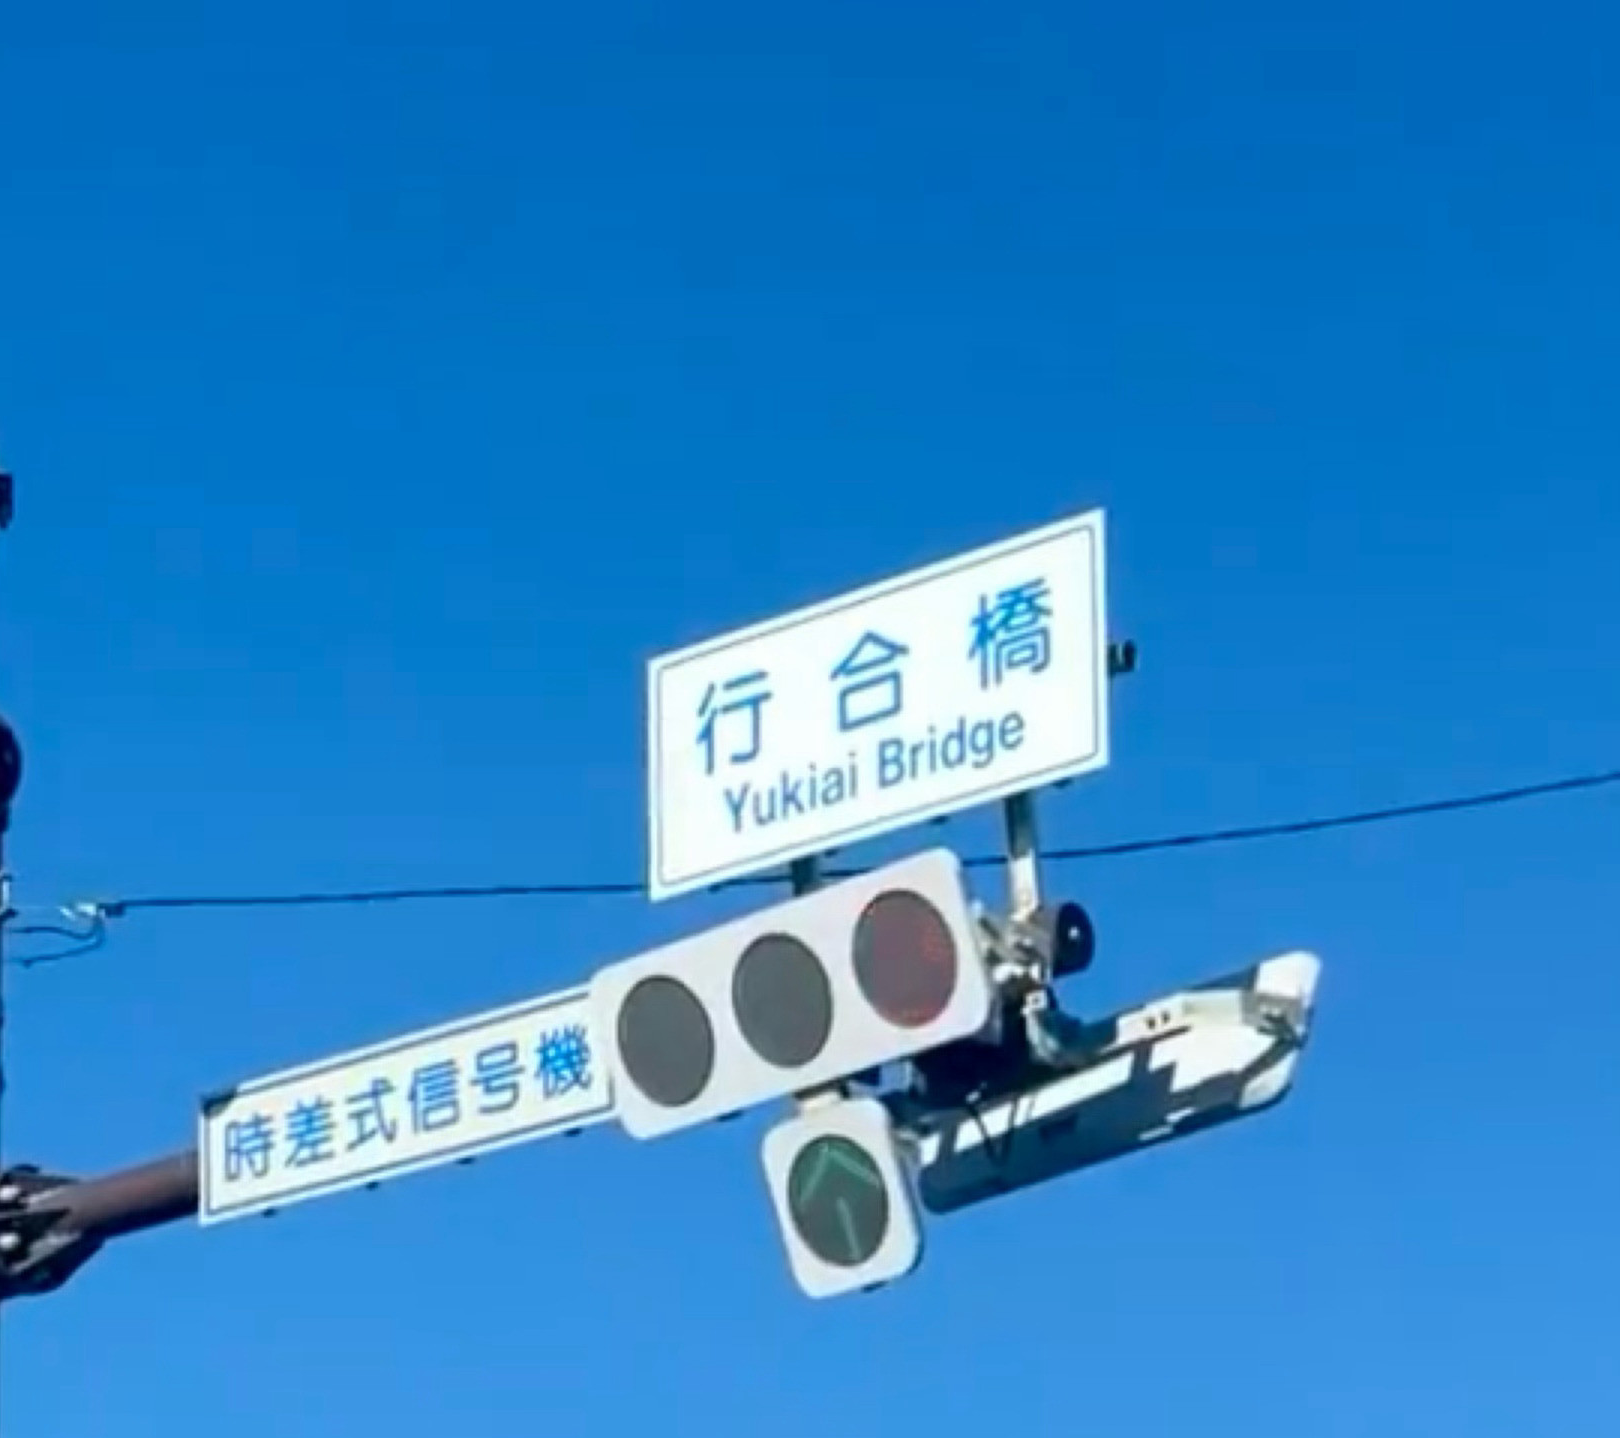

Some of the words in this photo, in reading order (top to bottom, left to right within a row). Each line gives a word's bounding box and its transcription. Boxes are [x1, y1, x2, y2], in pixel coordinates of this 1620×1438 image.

[695, 576, 1053, 776] 行合橋
[722, 750, 858, 833] Yukiai
[878, 710, 1026, 789] Bridge
[223, 1023, 593, 1183] 時差式信号機
